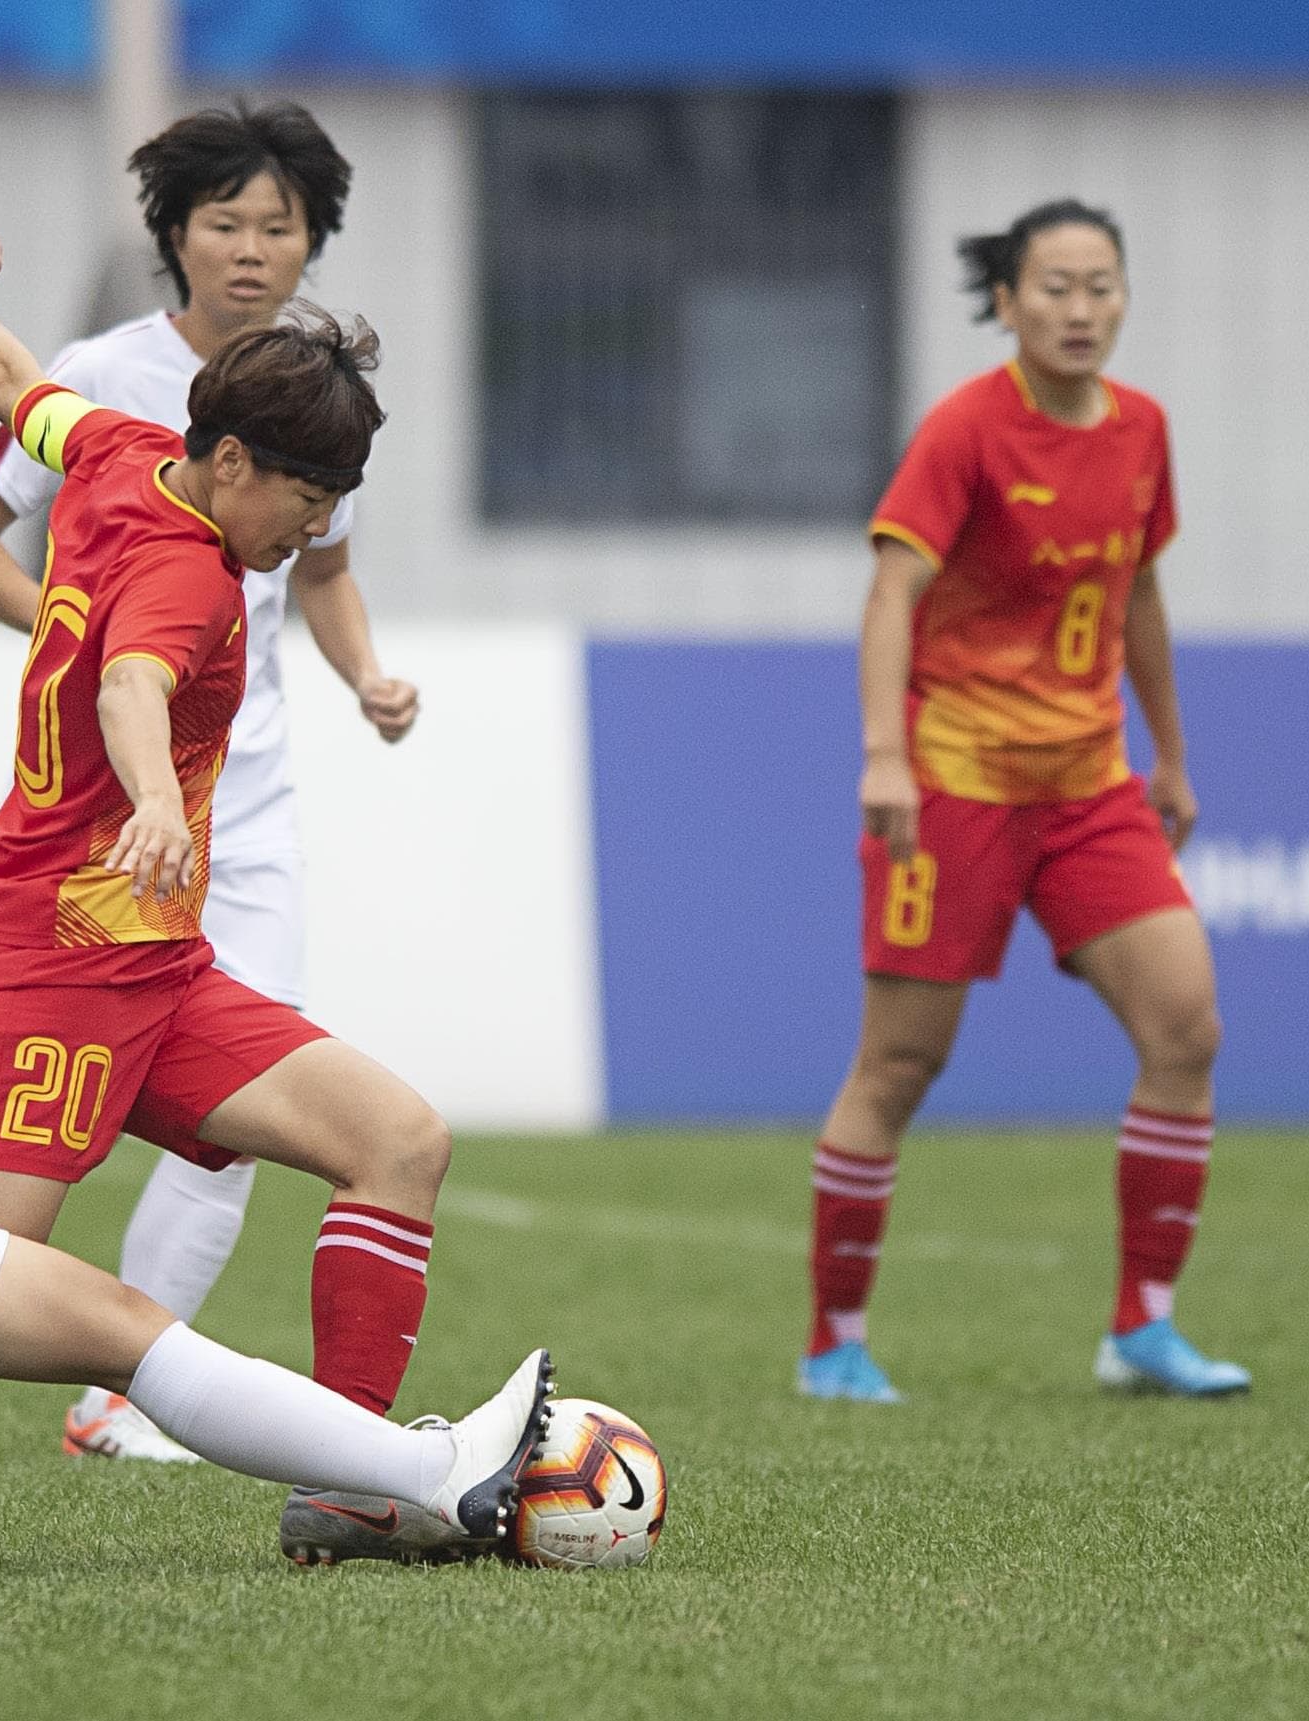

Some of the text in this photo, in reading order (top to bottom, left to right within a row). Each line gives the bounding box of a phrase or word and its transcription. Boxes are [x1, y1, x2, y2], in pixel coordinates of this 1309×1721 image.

[1056, 580, 1106, 675] 8
[884, 850, 938, 947] 8
[0, 1036, 112, 1151] 20
[554, 1532, 596, 1544] MERLIN
